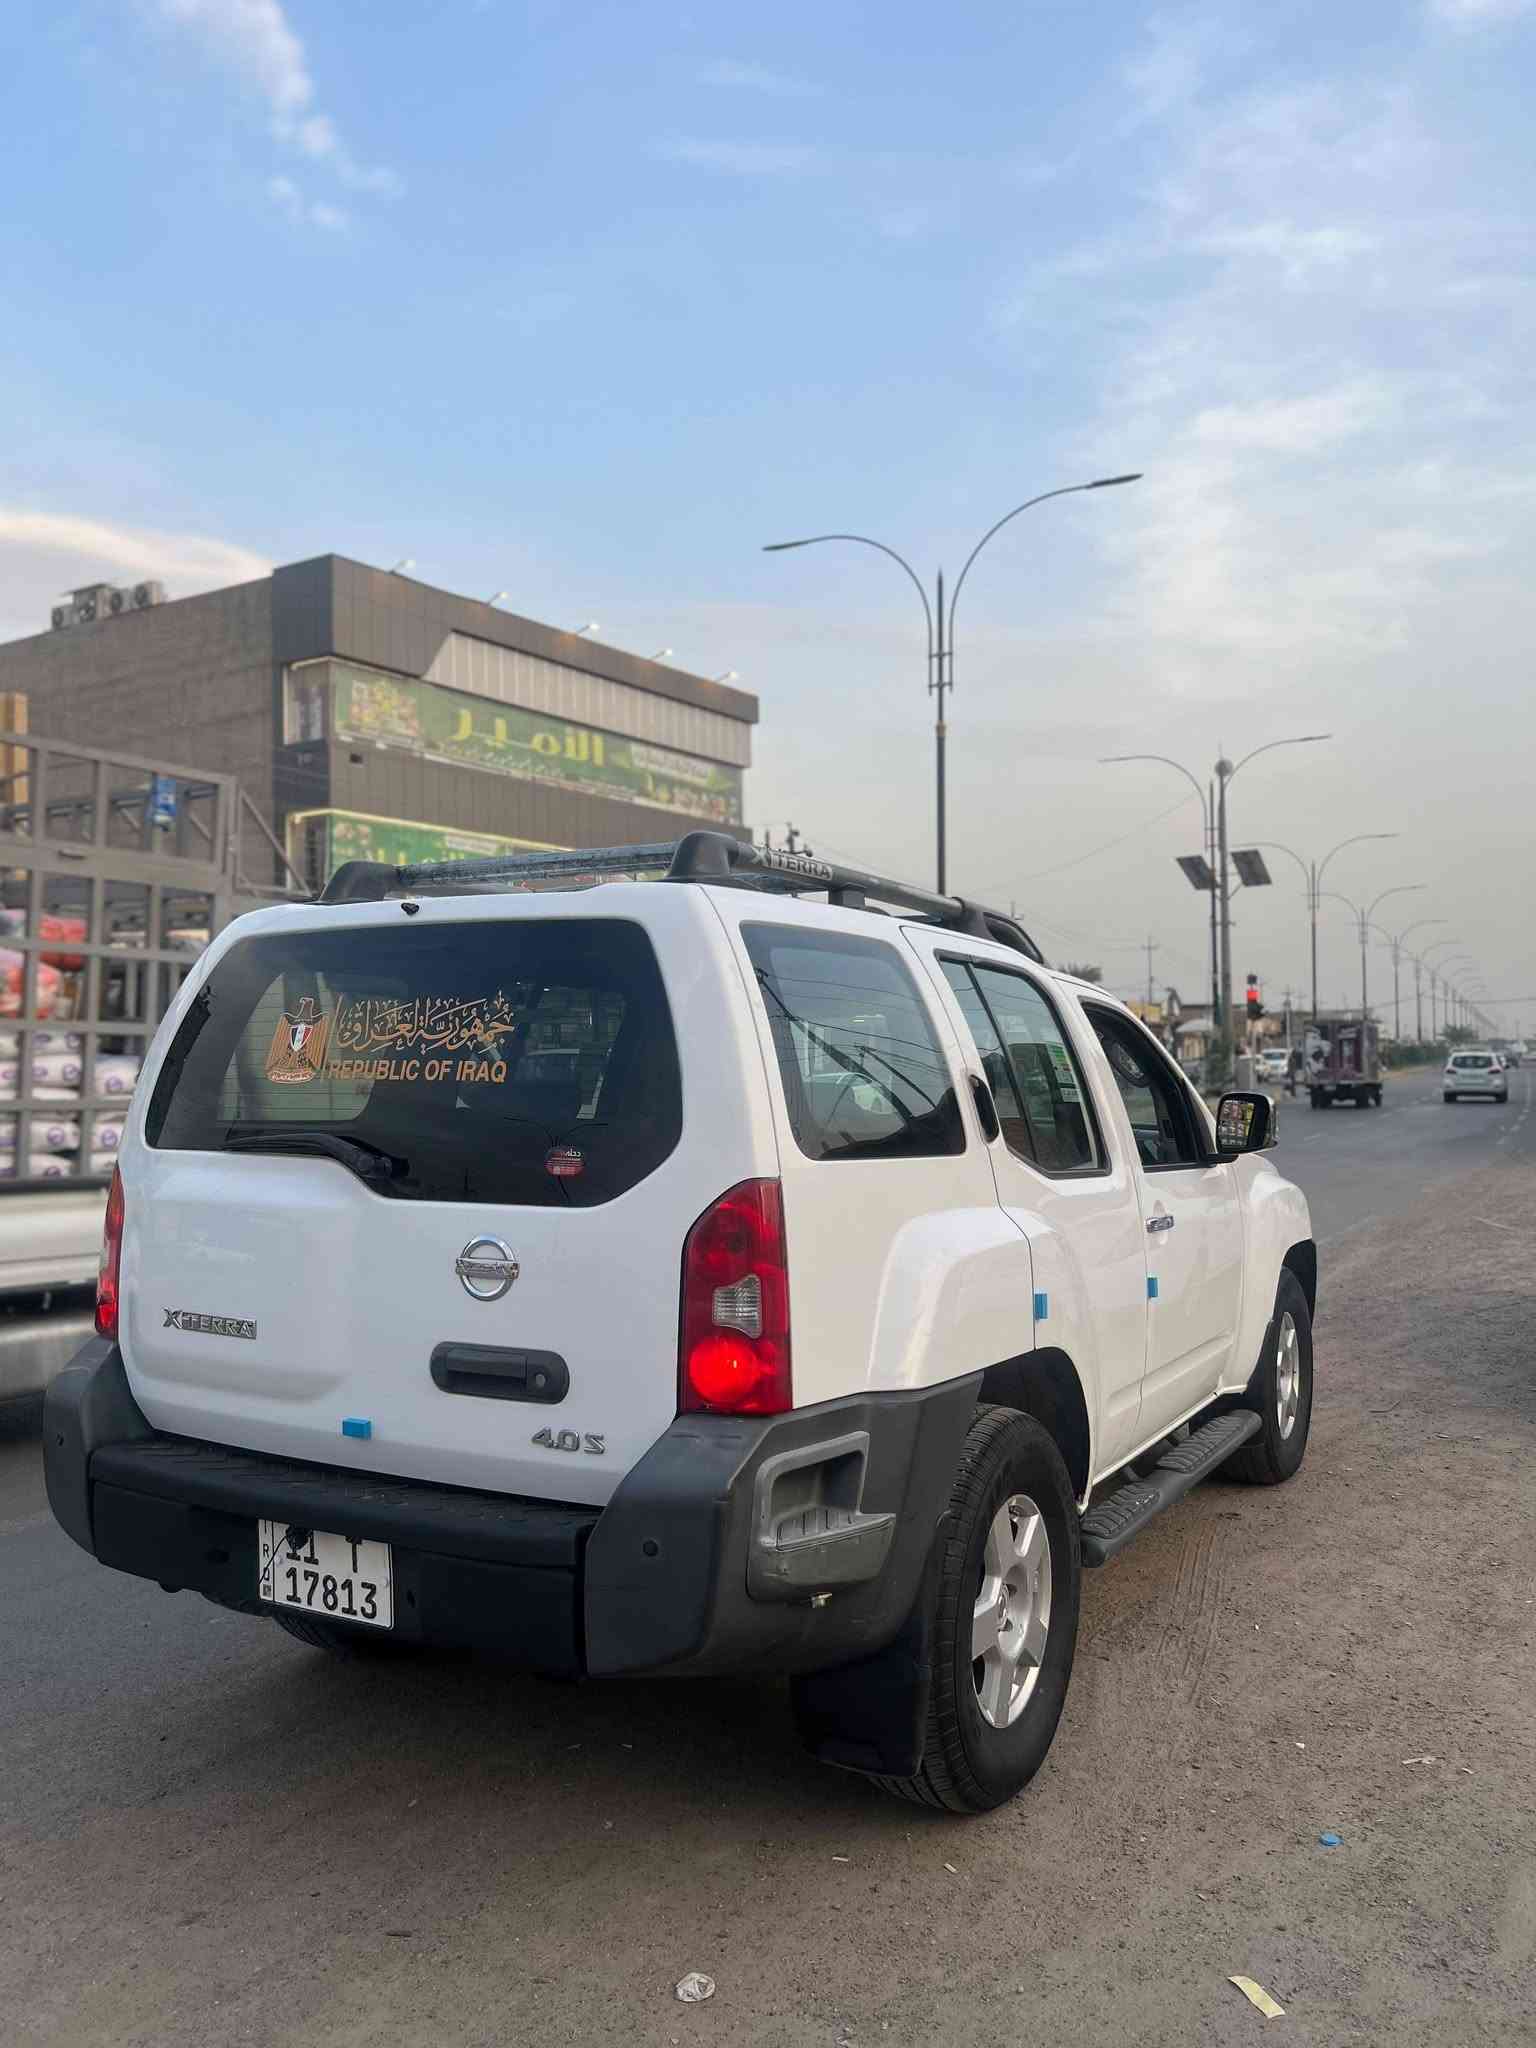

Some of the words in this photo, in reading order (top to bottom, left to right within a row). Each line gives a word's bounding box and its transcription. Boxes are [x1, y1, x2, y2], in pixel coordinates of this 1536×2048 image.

[751, 846, 833, 880] XTERRA
[327, 1059, 420, 1082] REPUBLIC
[424, 1060, 453, 1081] OF
[456, 1060, 507, 1083] IRAQ
[162, 1307, 257, 1340] XTERRA
[531, 1427, 580, 1453] 4.0
[583, 1432, 606, 1455] S
[286, 1566, 378, 1620] 17813
